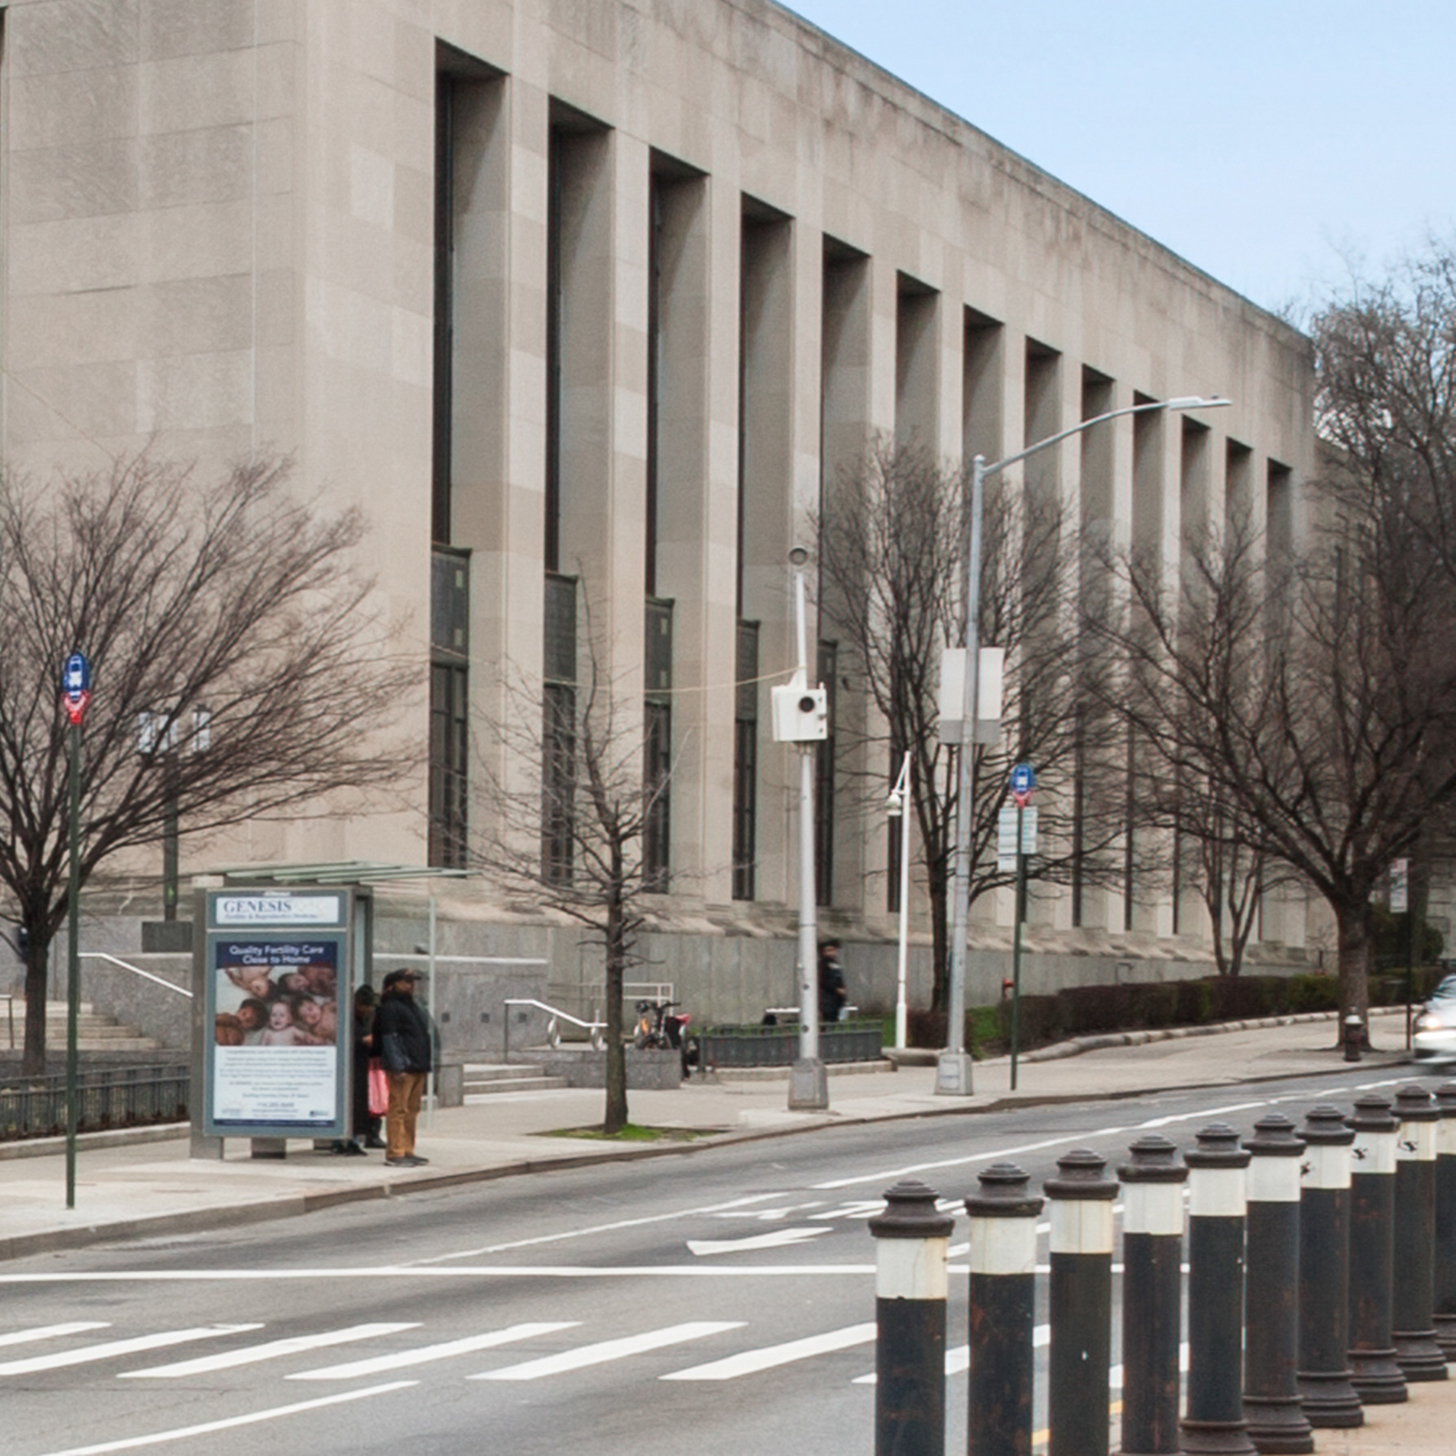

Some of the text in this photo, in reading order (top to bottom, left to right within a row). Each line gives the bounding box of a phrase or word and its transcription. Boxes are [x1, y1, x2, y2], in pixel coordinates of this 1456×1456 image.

[223, 899, 292, 913] GENESIS
[229, 945, 325, 956] Quality Fertility Care
[242, 955, 311, 964] Close to Home
